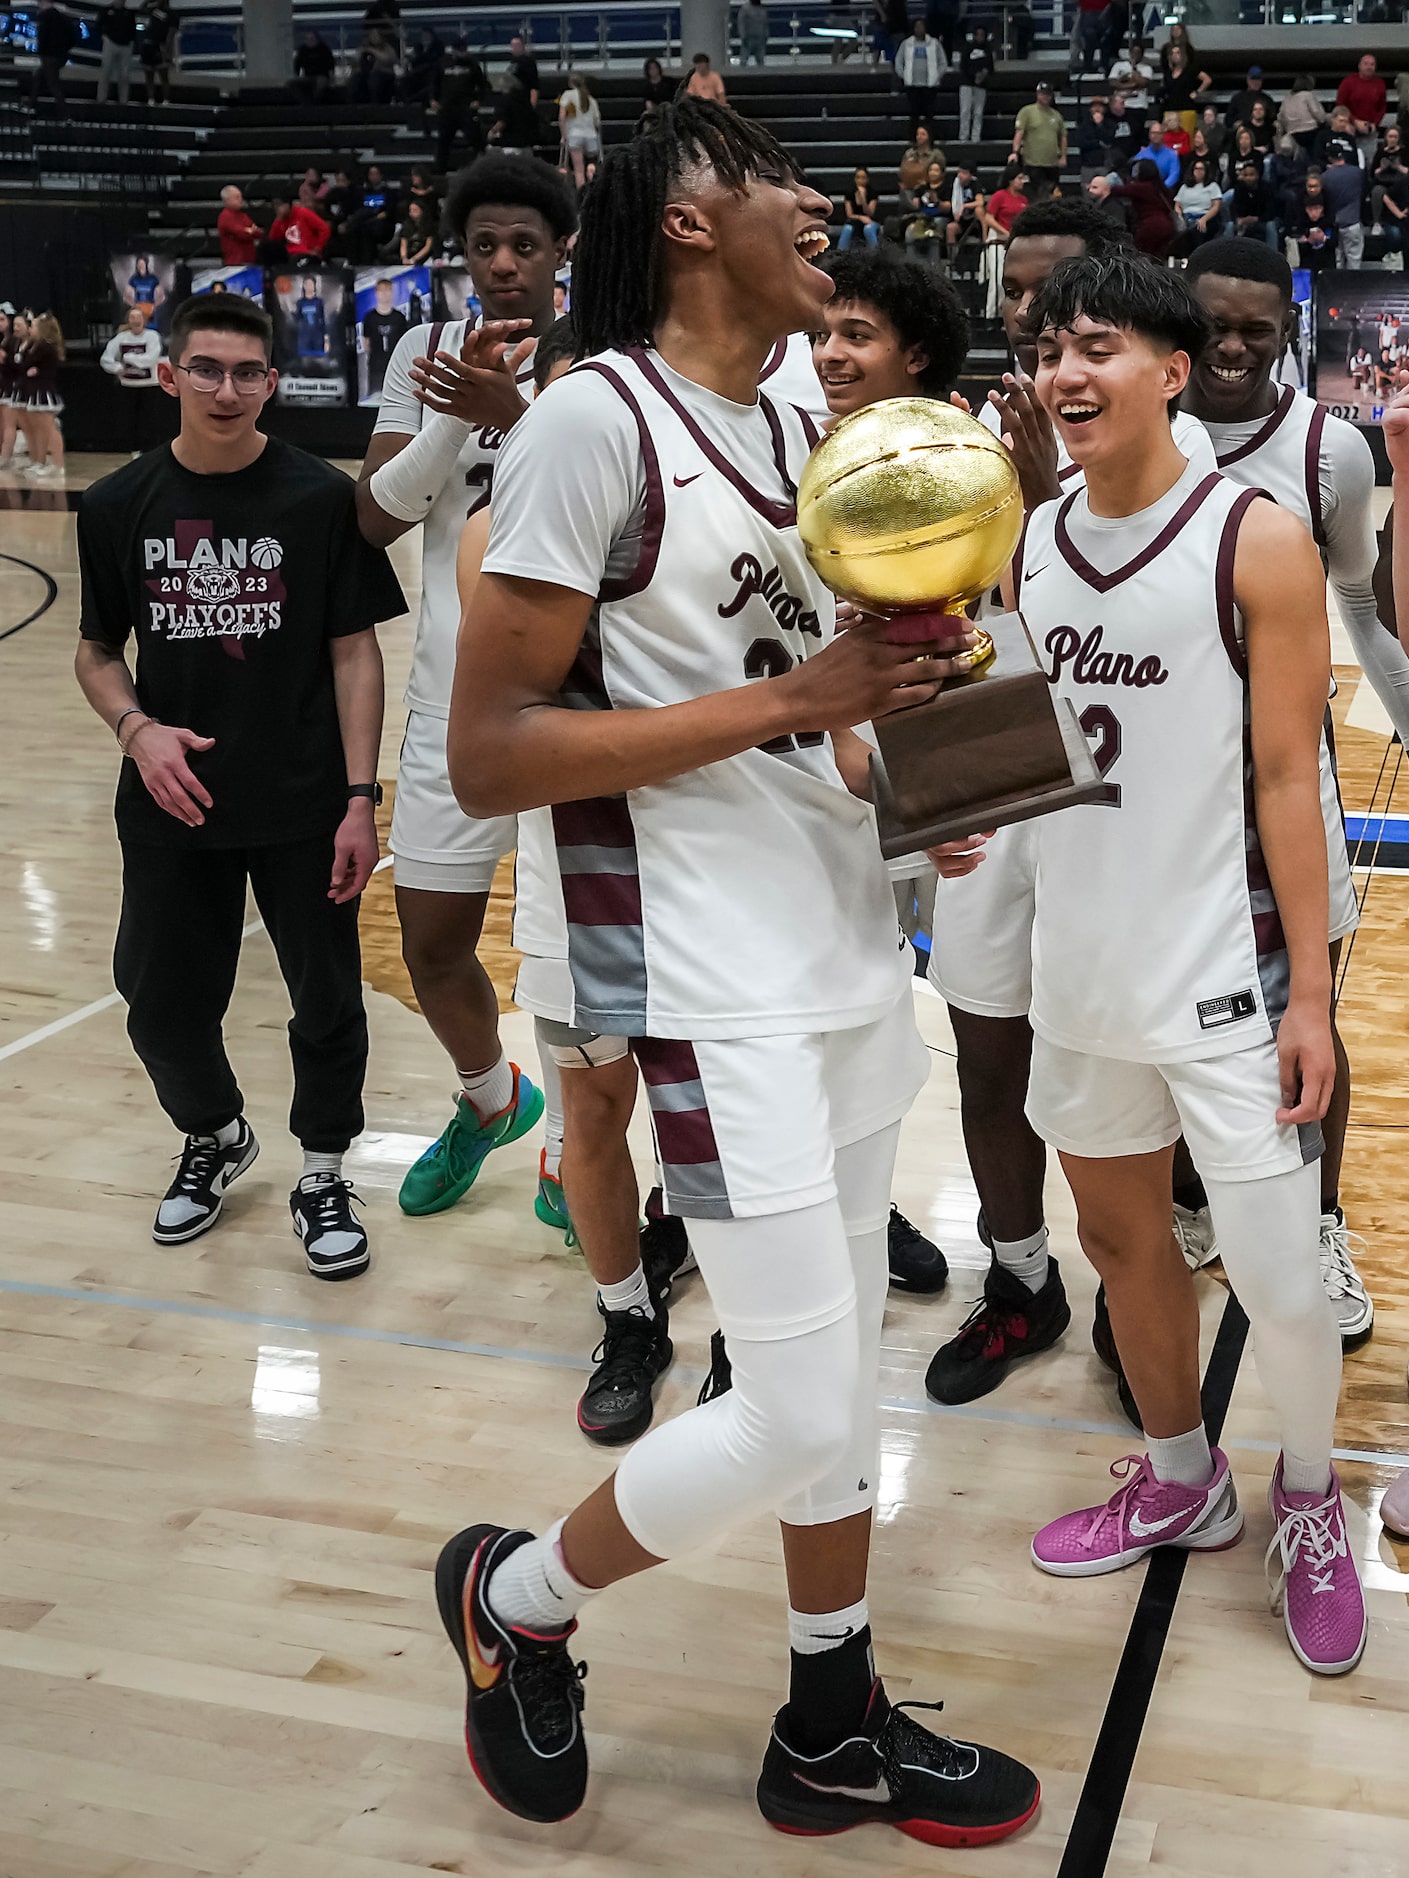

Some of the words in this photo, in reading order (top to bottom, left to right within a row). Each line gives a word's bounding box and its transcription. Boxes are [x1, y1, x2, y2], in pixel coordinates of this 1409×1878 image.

[161, 576, 183, 592] 20
[245, 576, 268, 592] 23
[149, 601, 282, 631] PLAYOFFS
[166, 624, 205, 640] Leave
[206, 627, 216, 637] a
[216, 619, 267, 640] Legacy
[1044, 624, 1169, 688] Plano
[1078, 704, 1122, 808] 2
[1238, 1000, 1247, 1011] L
